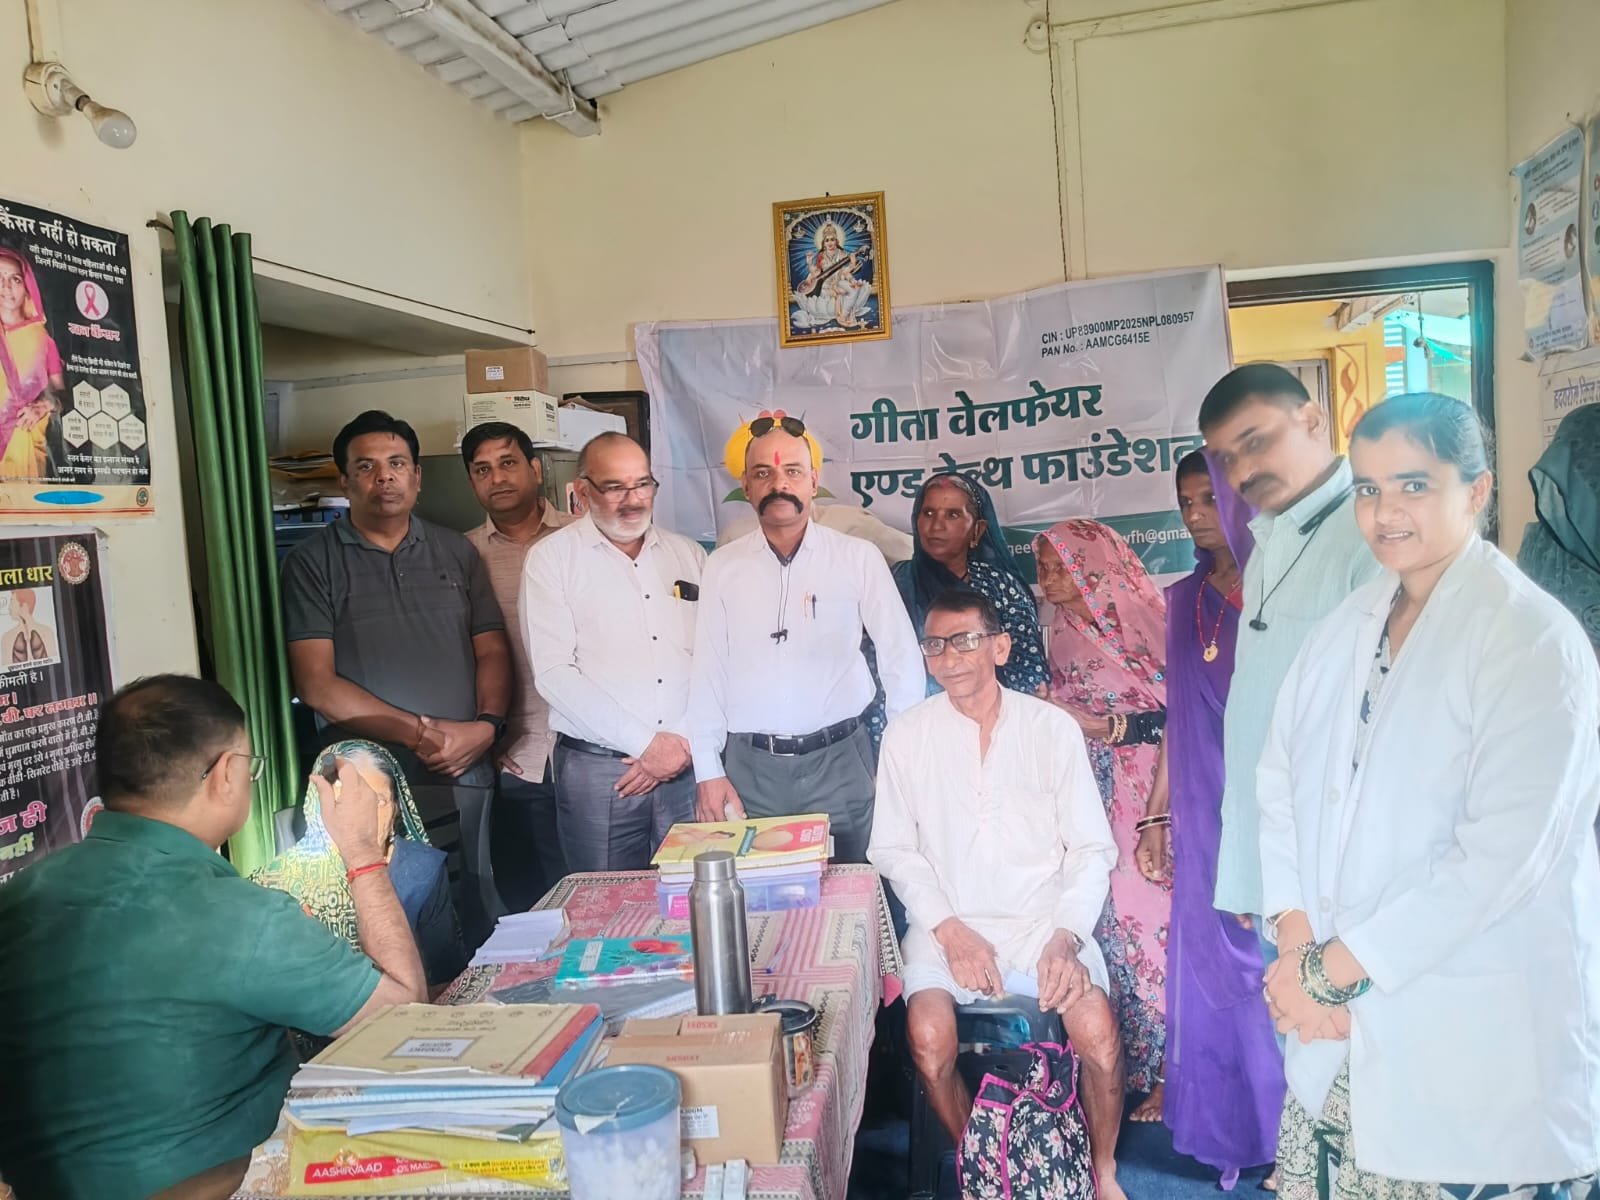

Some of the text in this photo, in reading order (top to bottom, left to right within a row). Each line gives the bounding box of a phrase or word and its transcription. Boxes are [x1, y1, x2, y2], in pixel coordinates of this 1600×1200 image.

[39, 219, 63, 245] नहीं
[66, 223, 78, 250] हो
[80, 234, 117, 257] सकता
[1041, 331, 1058, 344] CIN
[1041, 346, 1061, 358] PAN
[1085, 331, 1151, 350] AAMCG6415E
[850, 379, 1103, 444] गीता वेलफेयर
[850, 467, 926, 508] एण्ड
[26, 565, 54, 582] धार
[19, 800, 48, 829] ही
[311, 1162, 383, 1178] AASHIRVAAD
